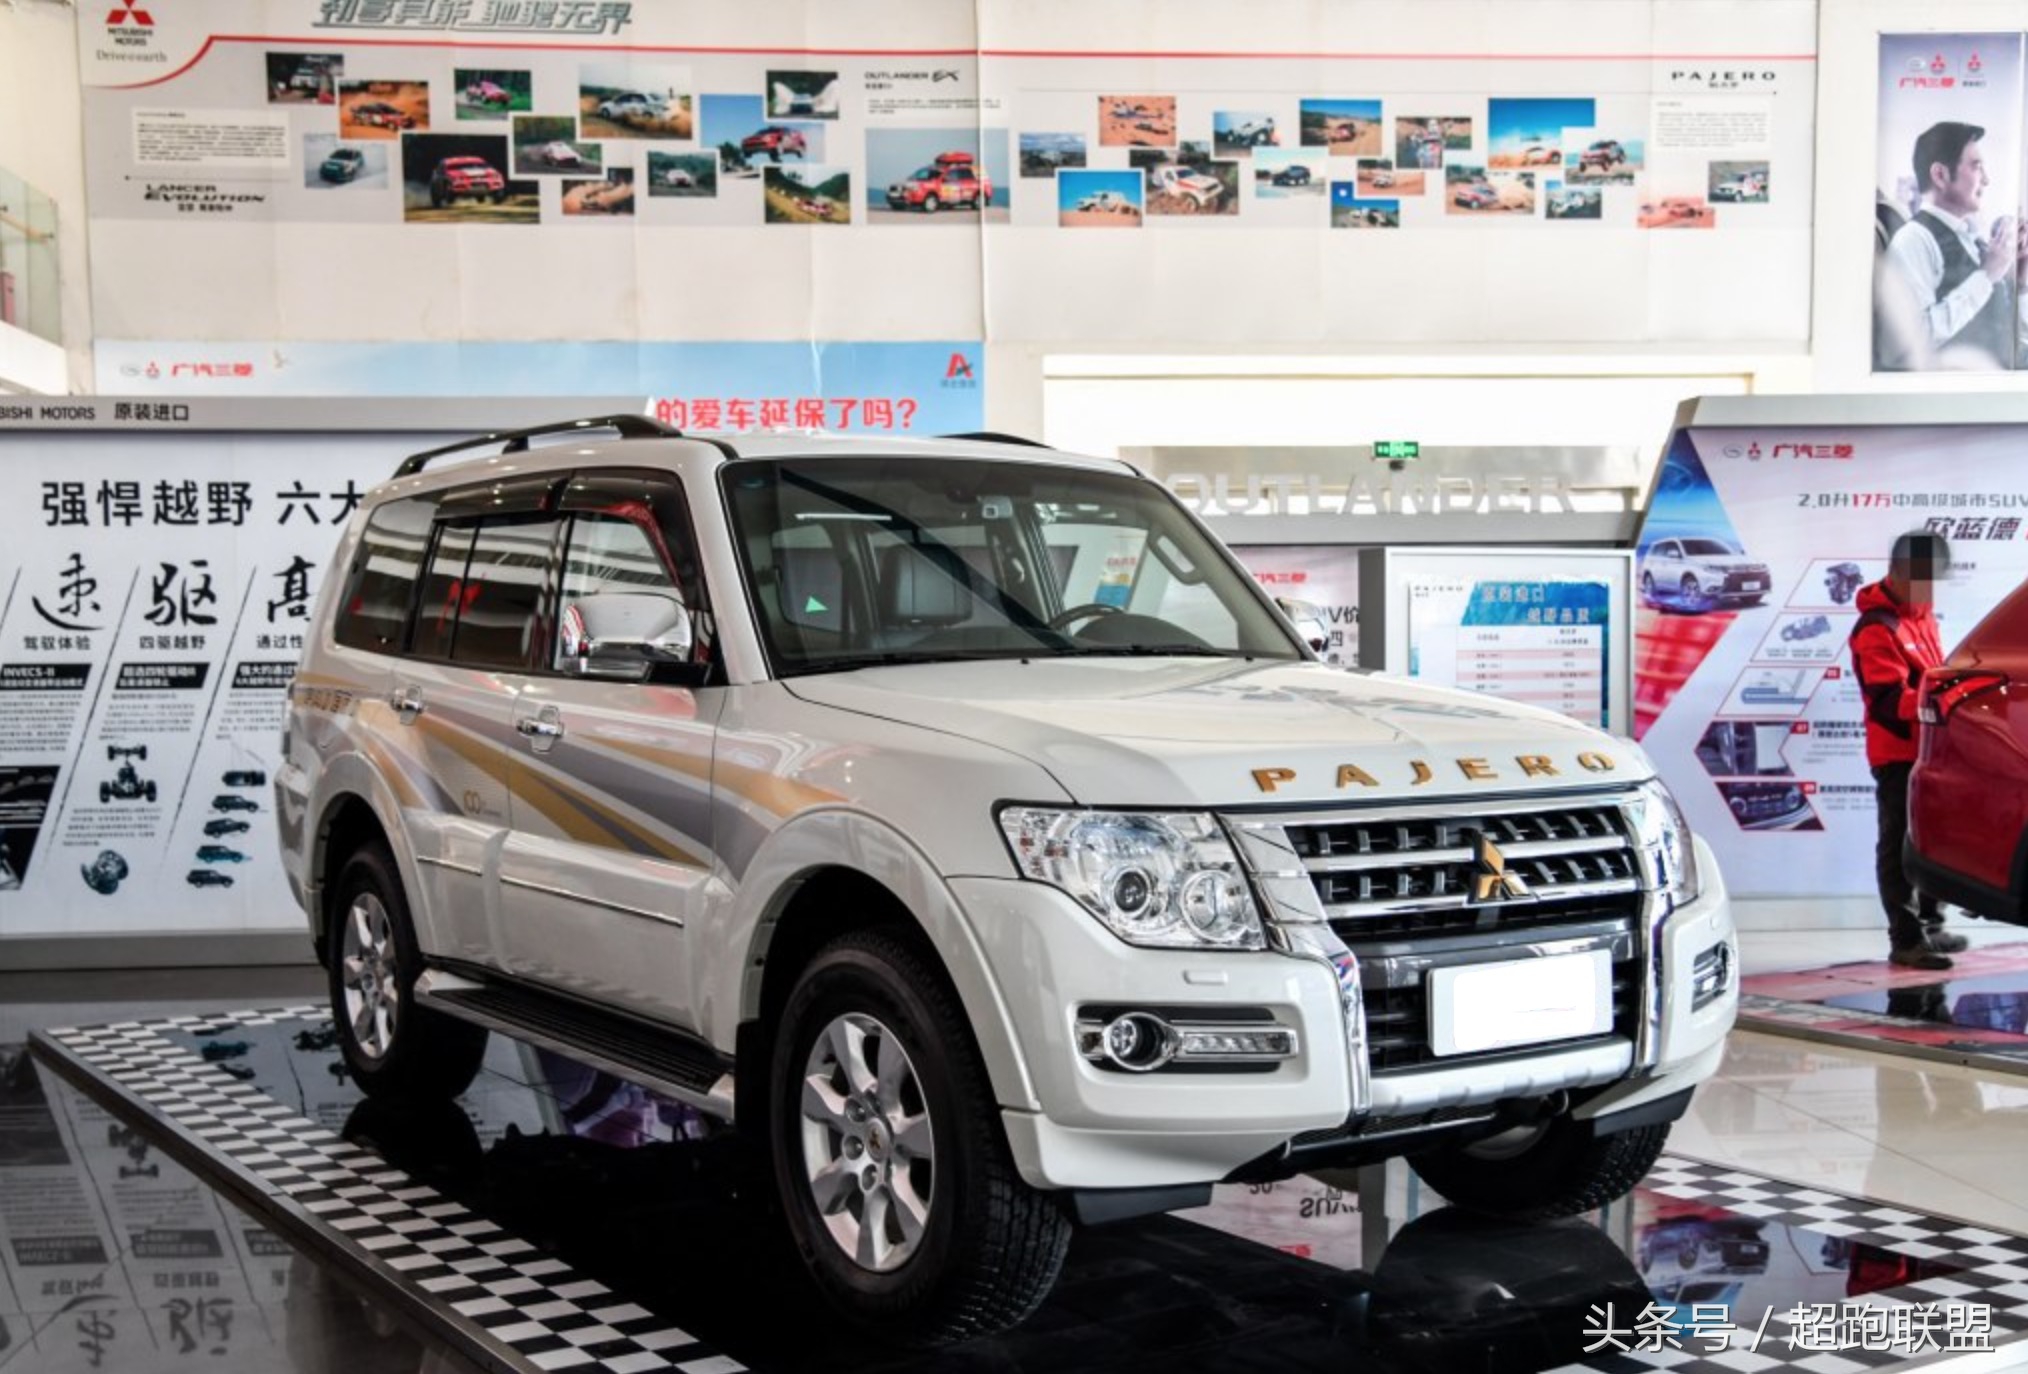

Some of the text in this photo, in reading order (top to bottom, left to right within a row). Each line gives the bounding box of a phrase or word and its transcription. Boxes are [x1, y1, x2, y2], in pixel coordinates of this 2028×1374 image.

[864, 71, 929, 79] OUTLANDER
[1671, 71, 1776, 80] PAJERO
[145, 184, 217, 193] LANCER
[171, 362, 254, 377] 广汽三菱
[41, 407, 95, 420] MOTORS
[114, 402, 189, 421] 原装进口
[1772, 444, 1854, 459] 广汽三菱
[1166, 472, 1577, 515] OUTLANDER
[42, 480, 252, 527] 强悍越野
[1923, 516, 2022, 541] 欧蓝德
[144, 559, 217, 626] 驱
[24, 635, 91, 651] 驾驭体验
[139, 634, 206, 650] 四驱越野
[257, 634, 303, 650] 通过性
[1251, 751, 1616, 792] PAJERO
